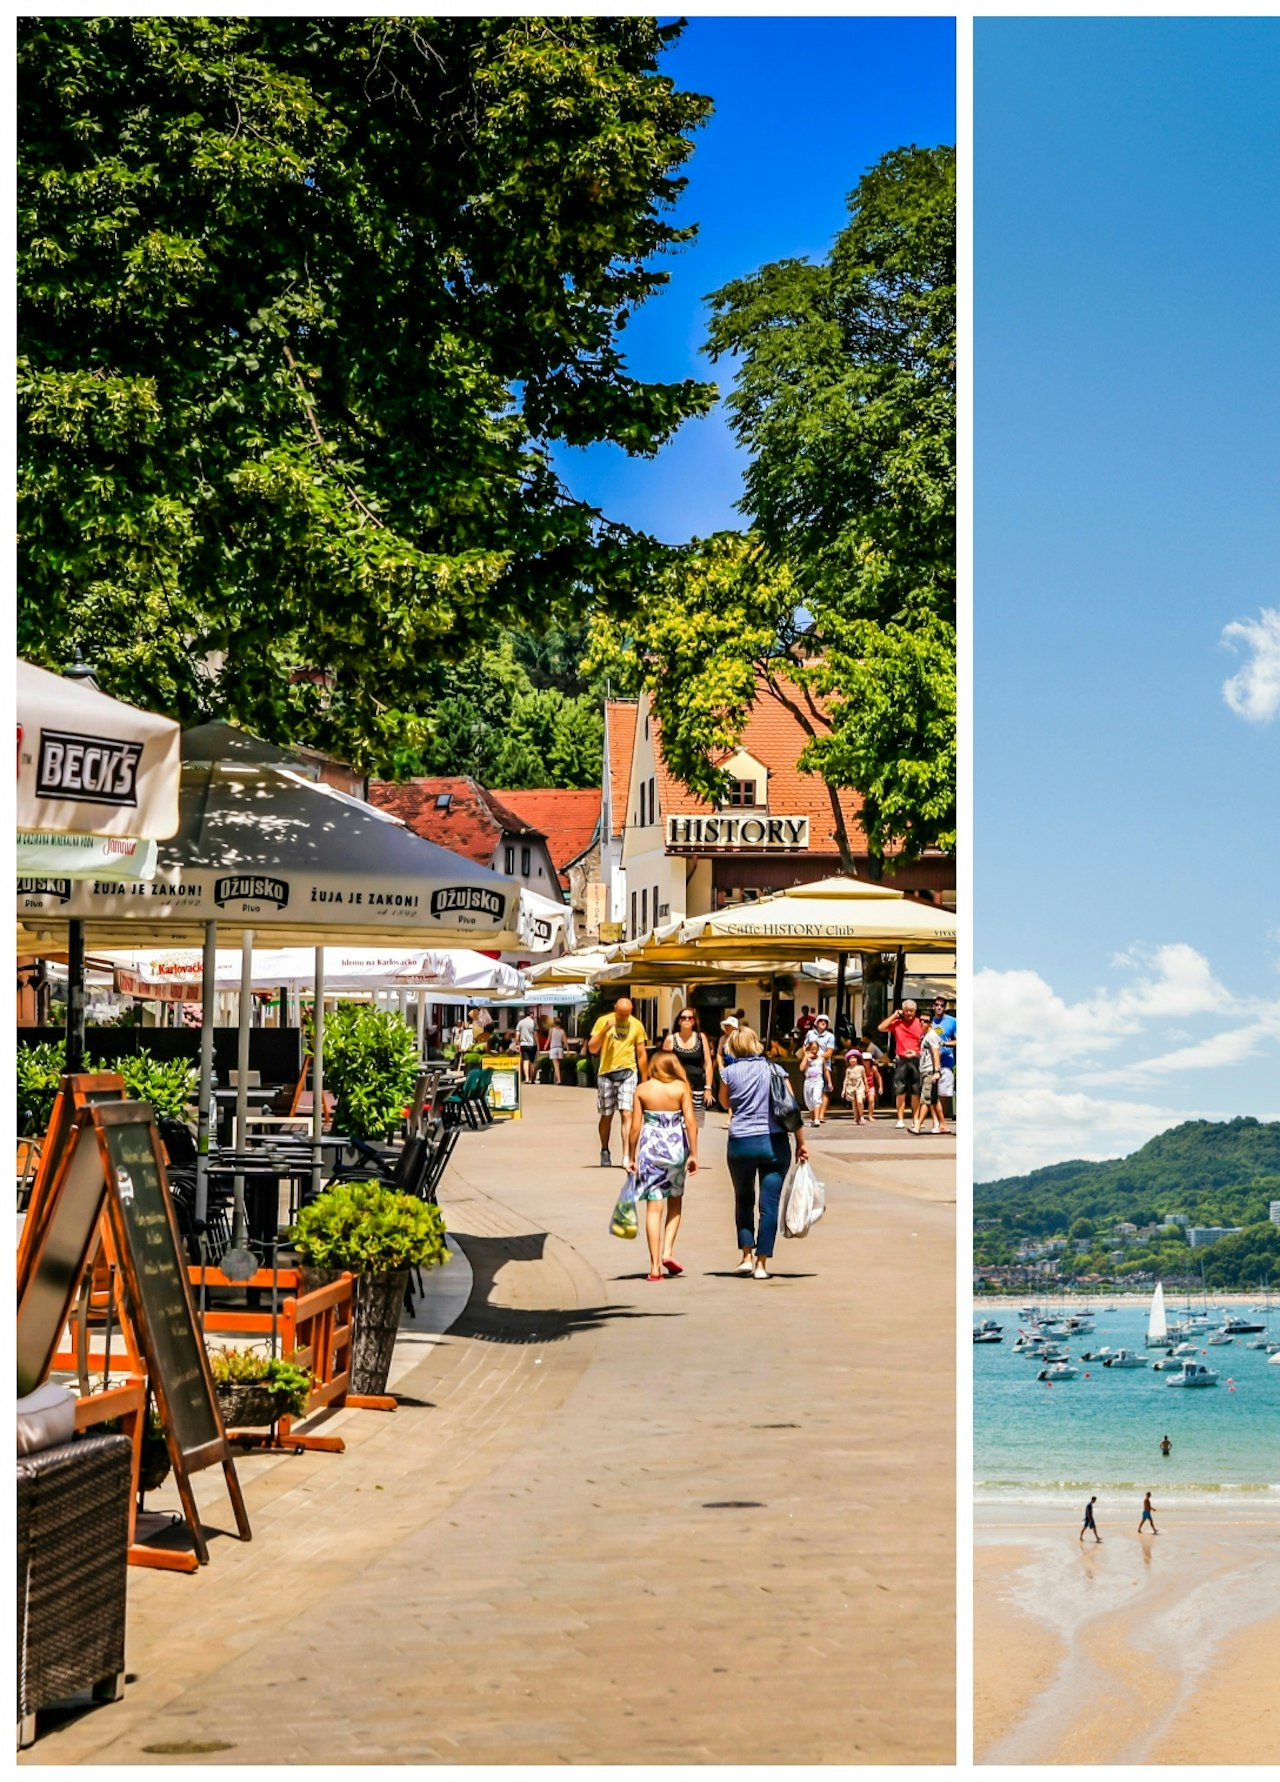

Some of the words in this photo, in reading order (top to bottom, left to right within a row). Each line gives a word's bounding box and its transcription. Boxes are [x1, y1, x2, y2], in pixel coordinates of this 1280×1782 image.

[41, 741, 137, 795] BECK'S
[669, 818, 807, 844] HISTORY
[93, 880, 126, 895] ŽUJA
[131, 883, 145, 895] JE
[151, 883, 203, 897] ZAKON!
[220, 877, 284, 900] Ožujsko
[25, 899, 43, 908] Pivo
[311, 887, 343, 903] ŽUJA
[348, 892, 362, 904] JE
[368, 893, 419, 908] ZAKON!
[436, 888, 501, 914] Ožujsko
[242, 903, 261, 913] Pivo
[458, 914, 476, 924] Pivo
[727, 923, 760, 935] Caffe
[763, 923, 823, 936] HISTORY
[825, 925, 855, 936] Club
[341, 958, 364, 966] Idemo
